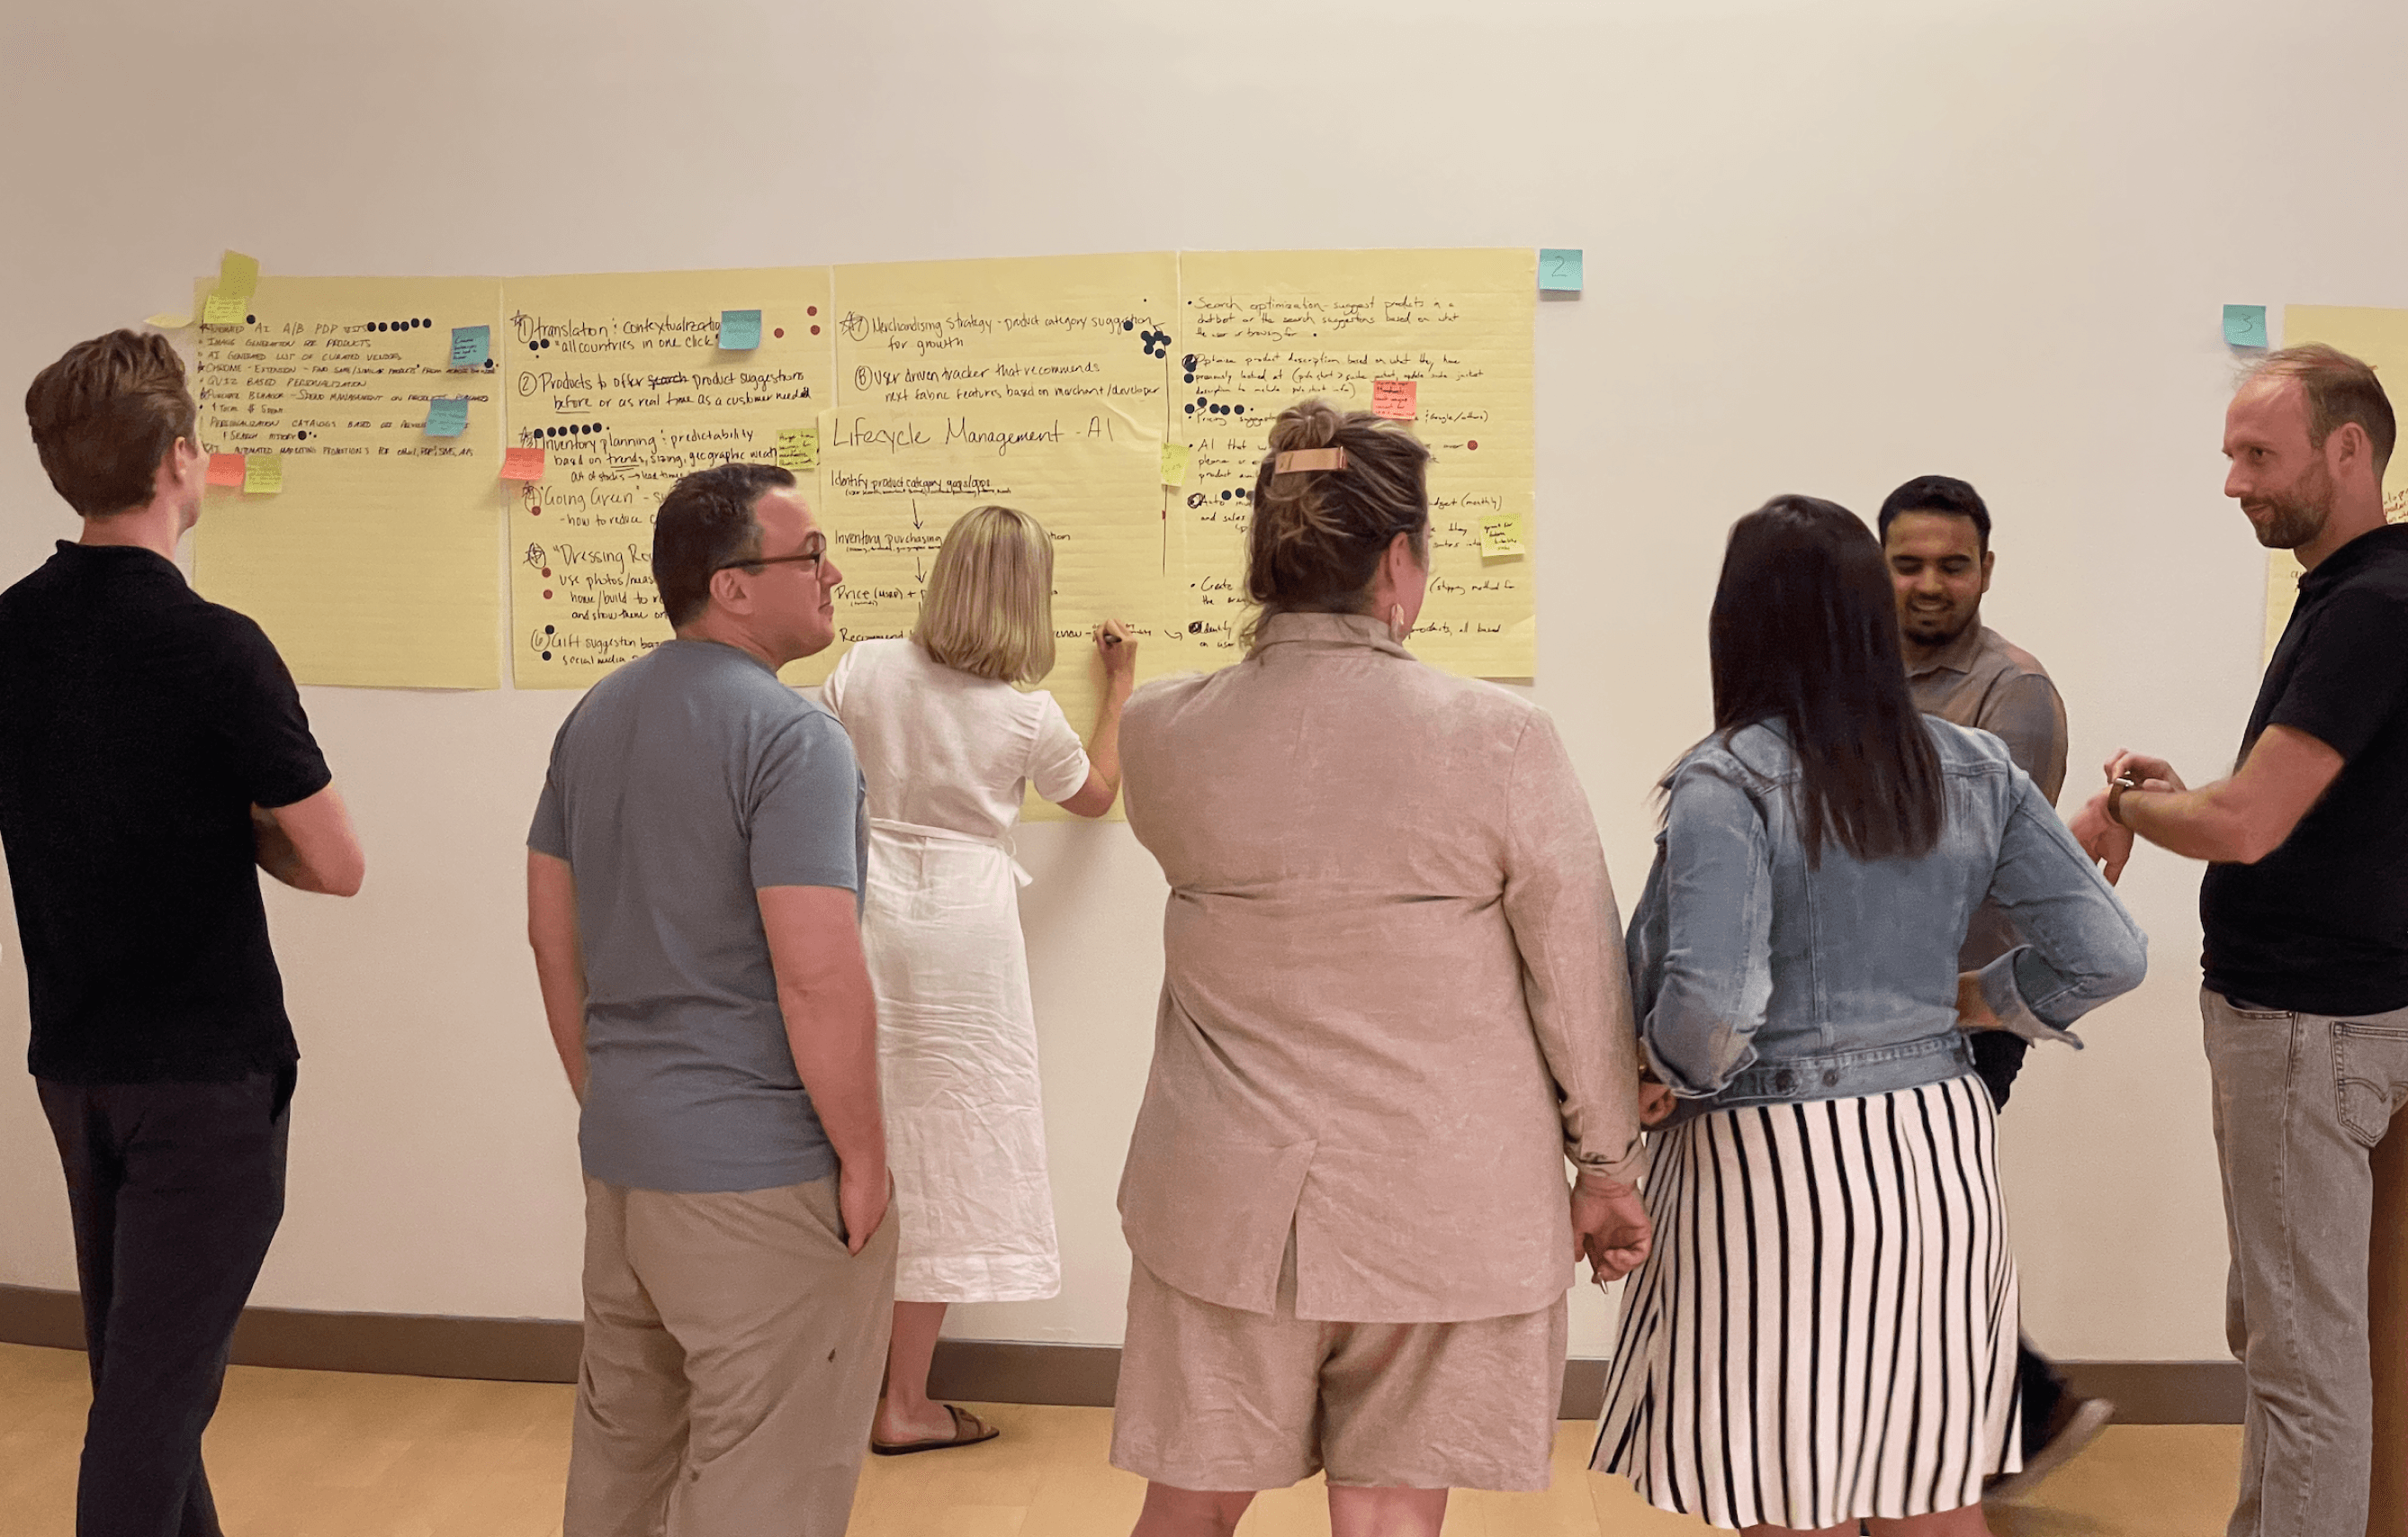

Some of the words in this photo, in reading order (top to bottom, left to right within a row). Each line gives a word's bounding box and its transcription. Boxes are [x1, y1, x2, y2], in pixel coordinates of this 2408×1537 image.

[1551, 256, 1568, 277] 2
[1194, 297, 1243, 311] Search
[1250, 296, 1325, 315] optimization
[623, 315, 720, 335] contextualizatio
[1004, 312, 1039, 331] product
[1045, 314, 1087, 331] category
[1092, 314, 1152, 335] suggetion
[1282, 312, 1316, 324] search
[2238, 313, 2253, 333] 3
[255, 322, 270, 334] AI
[283, 322, 304, 336] A/B
[315, 323, 338, 334] PDP
[1246, 328, 1282, 342] browsing
[1284, 327, 1298, 337] for
[642, 338, 653, 348] in
[659, 338, 681, 348] one
[888, 335, 908, 351] for
[917, 337, 964, 357] growth
[208, 351, 220, 360] AI
[321, 353, 360, 361] CURATED
[206, 363, 242, 373] CHROME
[874, 370, 901, 385] User
[904, 368, 939, 382] driven
[942, 364, 990, 382] tracker
[995, 363, 1020, 377] that
[1024, 362, 1100, 376] recommends
[207, 375, 238, 385] QUIZ
[247, 378, 276, 386] BASED
[538, 371, 593, 392] Products
[598, 373, 606, 390] to
[613, 372, 644, 388] offer
[692, 372, 736, 390] product
[740, 369, 804, 391] suggestions
[553, 394, 593, 409] before
[598, 398, 612, 407] or
[618, 398, 633, 408] as
[638, 393, 660, 406] real
[697, 394, 711, 406] as
[726, 391, 773, 404] customer
[885, 389, 909, 402] next
[957, 387, 1002, 400] features
[1006, 383, 1035, 399] based
[1038, 388, 1049, 397] on
[600, 432, 657, 454] planning
[670, 428, 754, 449] predictability
[833, 417, 931, 454] Lifecycle
[945, 416, 1065, 457] Management
[1088, 416, 1114, 442] AI
[1198, 438, 1214, 452] AI
[1227, 438, 1246, 450] that
[831, 470, 868, 490] Identify
[596, 514, 606, 526] to
[609, 513, 642, 526] reduce
[1200, 512, 1216, 521] and
[1223, 513, 1244, 523] sales
[835, 530, 881, 549] Inventory
[559, 573, 580, 586] use
[633, 591, 648, 605] to
[834, 585, 870, 599] Price
[571, 611, 589, 620] and
[562, 654, 594, 666] social
[598, 654, 625, 664] media
